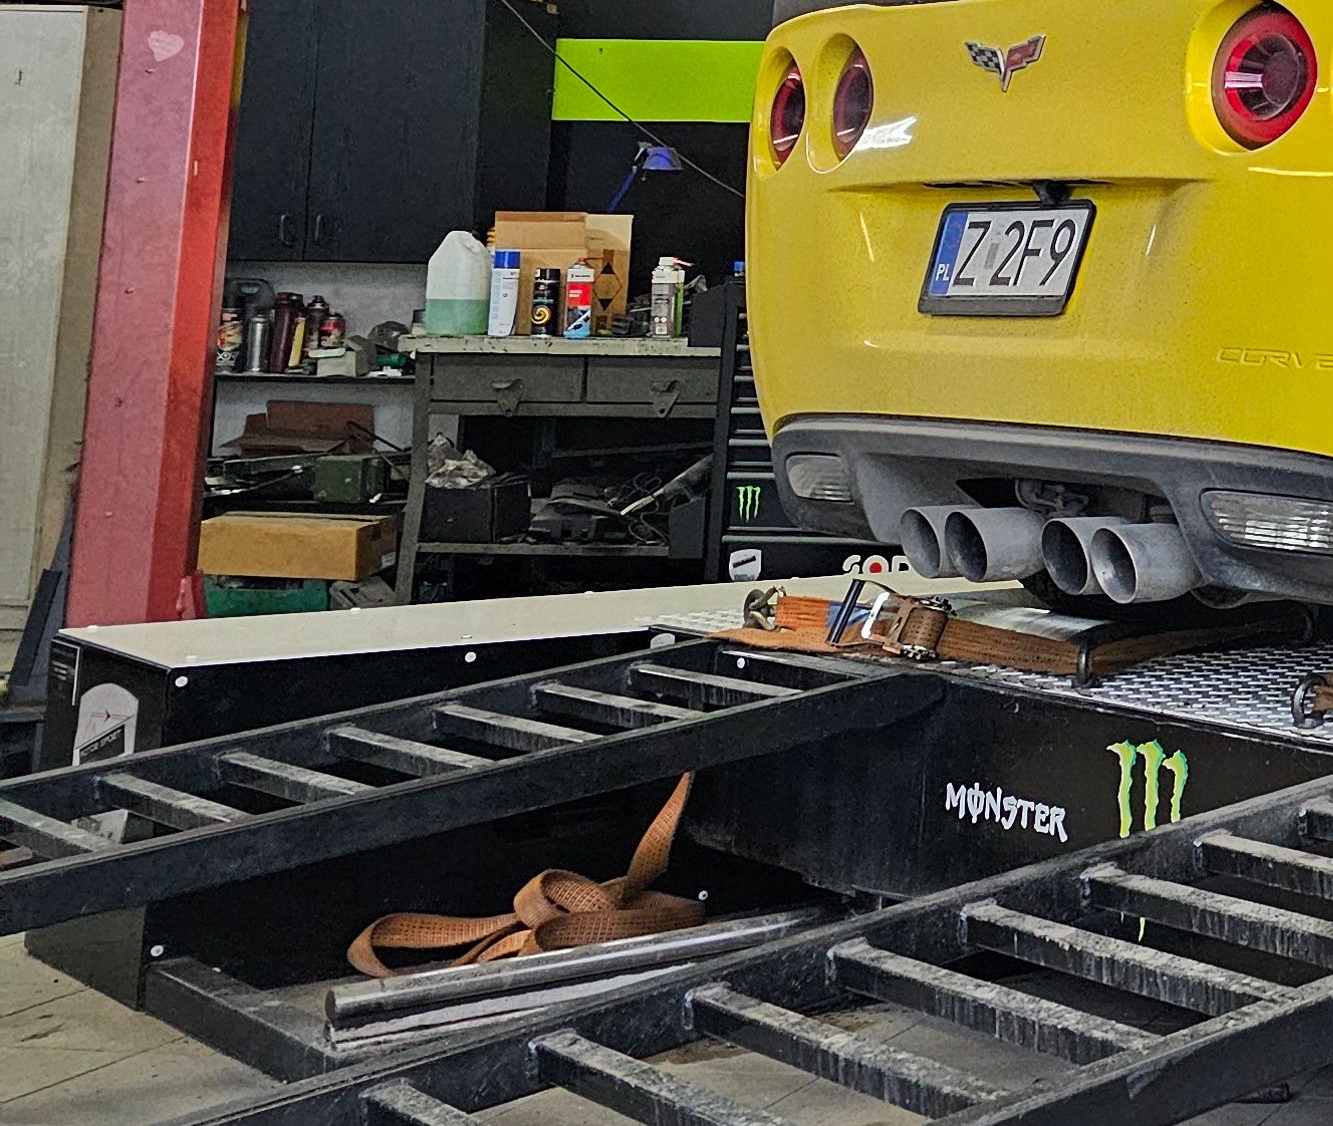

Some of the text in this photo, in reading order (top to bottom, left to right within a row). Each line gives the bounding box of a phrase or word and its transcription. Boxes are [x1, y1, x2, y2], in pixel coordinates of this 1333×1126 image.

[935, 263, 950, 282] PL
[952, 218, 1076, 287] Z 2F9
